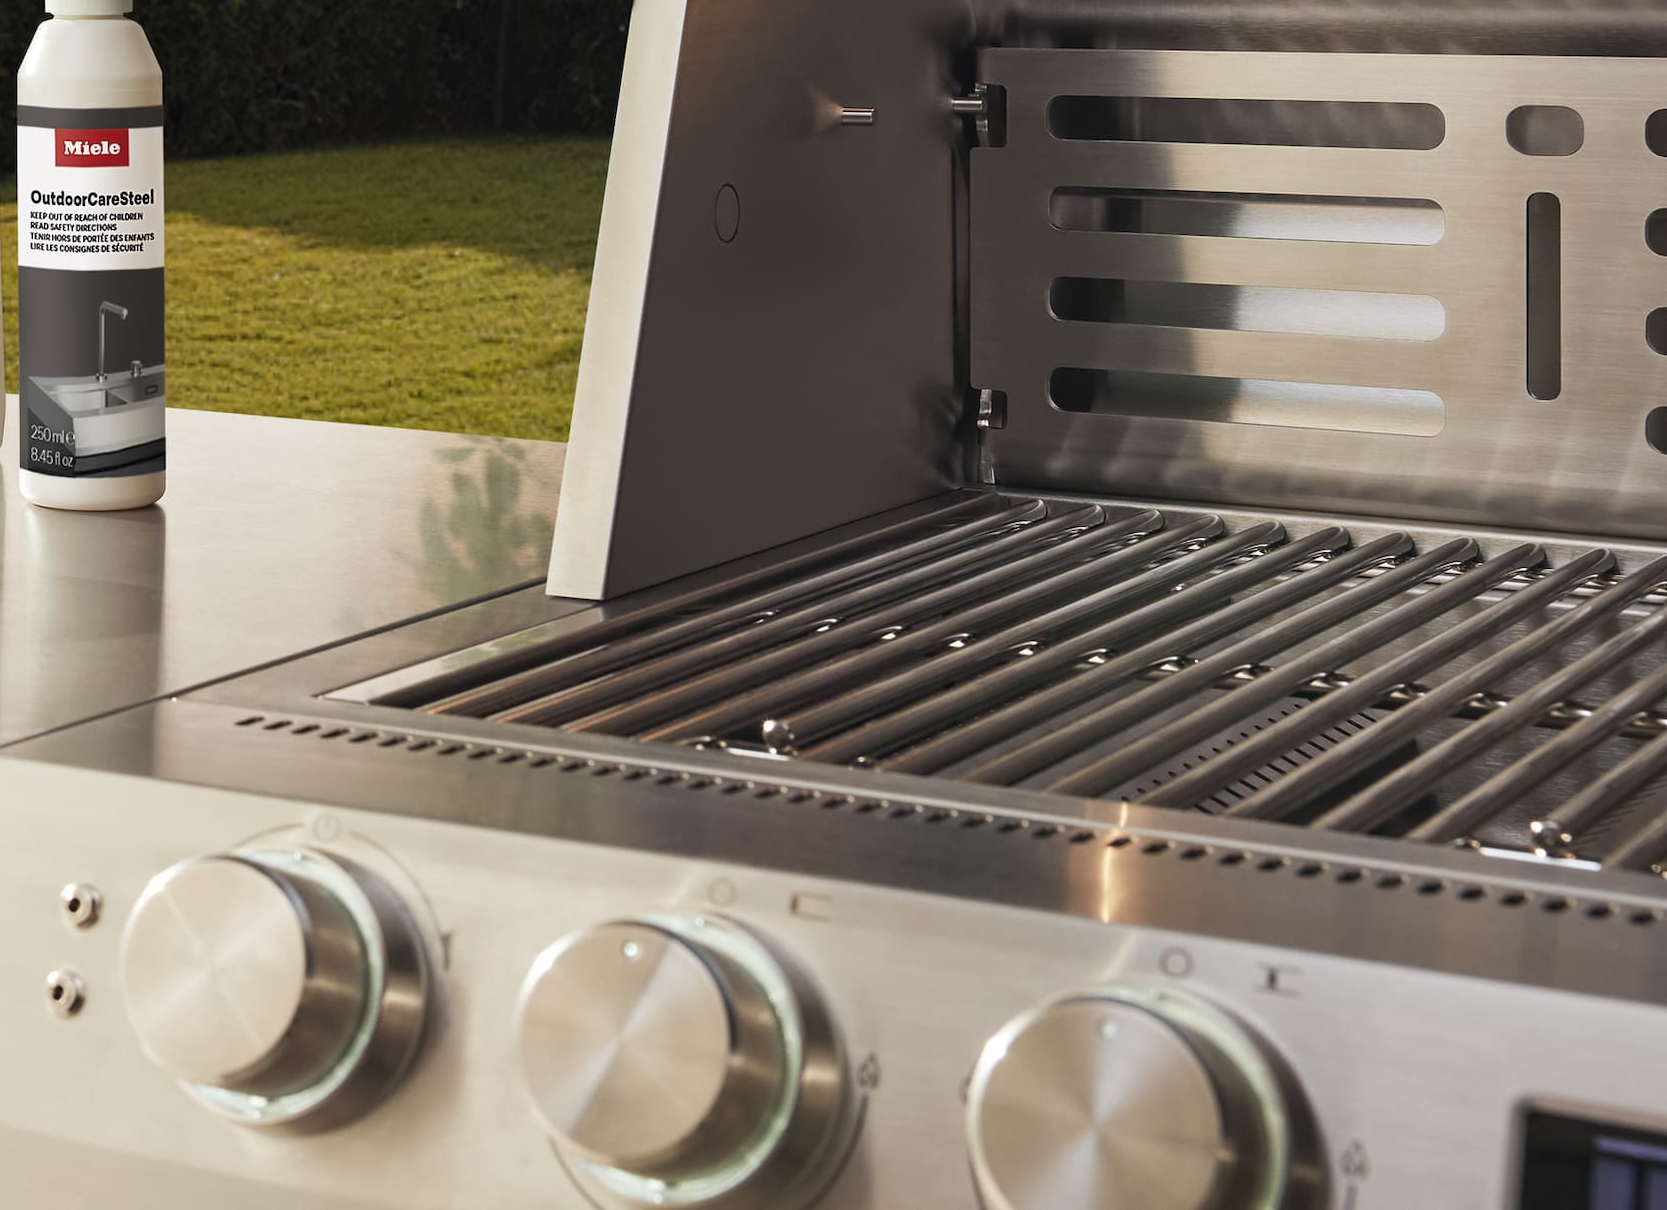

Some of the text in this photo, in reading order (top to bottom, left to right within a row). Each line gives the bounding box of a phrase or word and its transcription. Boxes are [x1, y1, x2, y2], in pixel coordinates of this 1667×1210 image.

[64, 140, 121, 155] Miele
[30, 189, 154, 206] OutdoorCareSteel
[30, 211, 143, 222] KEEP OUT OF REACH OF CHILDREN
[30, 221, 117, 232] READ SAFETY DIRECTIONS
[30, 232, 155, 243] TENIR HORS DE PORTÉE DES ENFANTS
[30, 242, 144, 253] LIRE LES CONSIGNES DE SÉCURITÉ
[30, 447, 74, 468] 8.45 fl oz
